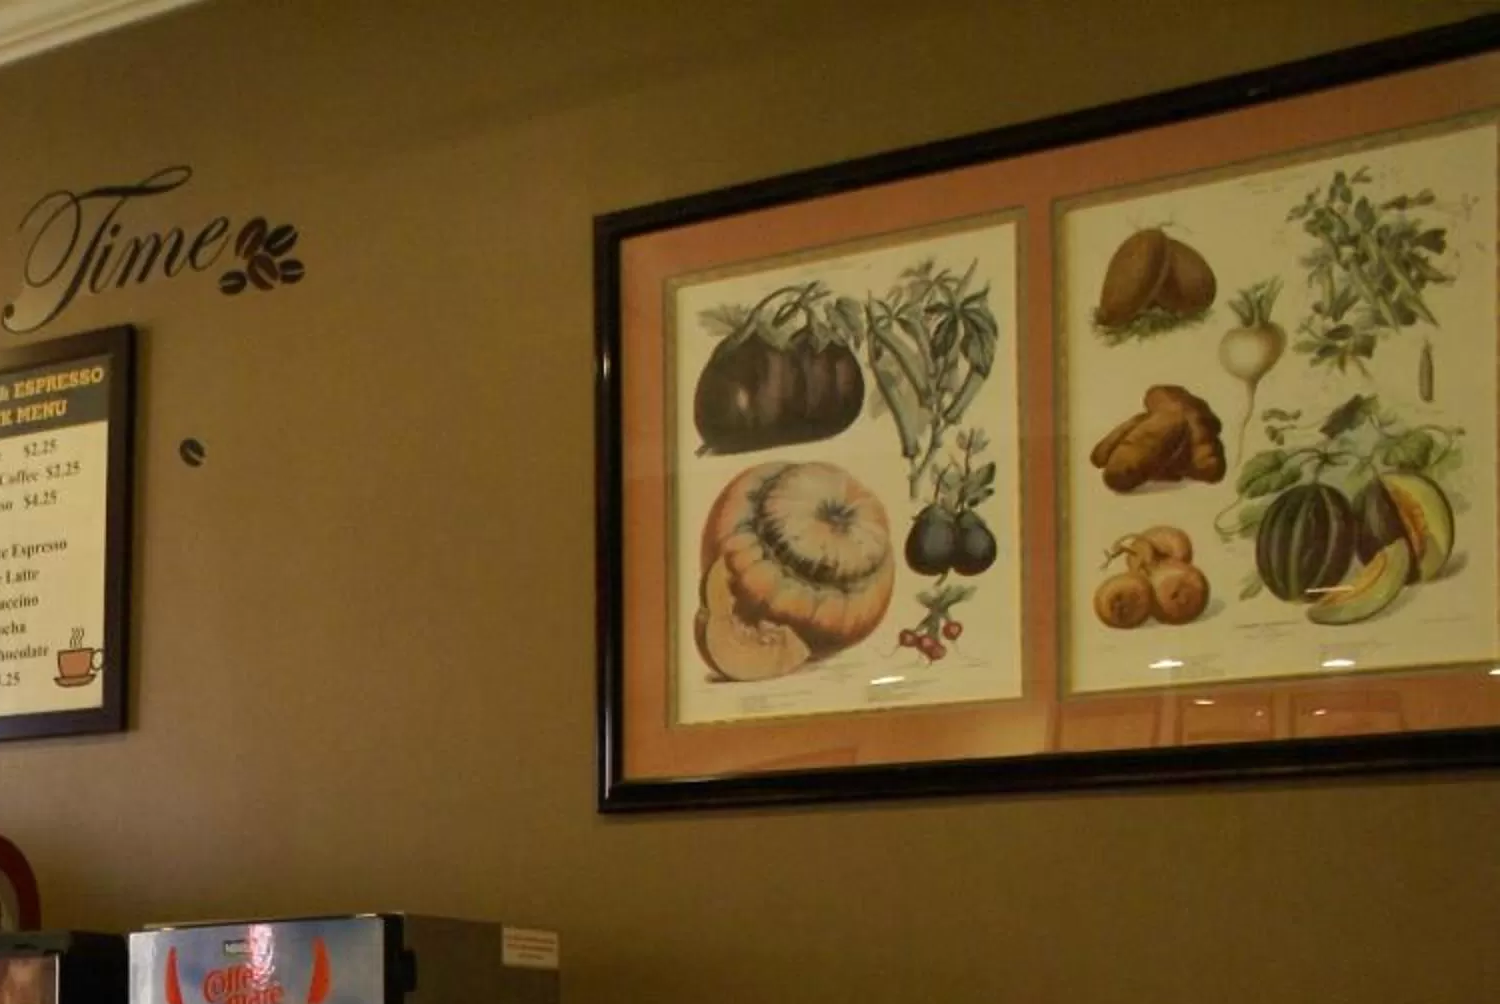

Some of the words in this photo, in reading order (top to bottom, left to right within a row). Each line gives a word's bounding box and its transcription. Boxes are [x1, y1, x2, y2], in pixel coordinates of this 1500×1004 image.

[1, 165, 230, 335] Time
[13, 367, 105, 397] ESPRESSO
[16, 400, 68, 424] MENU
[23, 438, 58, 458] $2.25
[45, 460, 81, 479] $2.25
[23, 489, 58, 509] $4.25
[11, 540, 68, 560] Espresso
[5, 568, 41, 585] Latte
